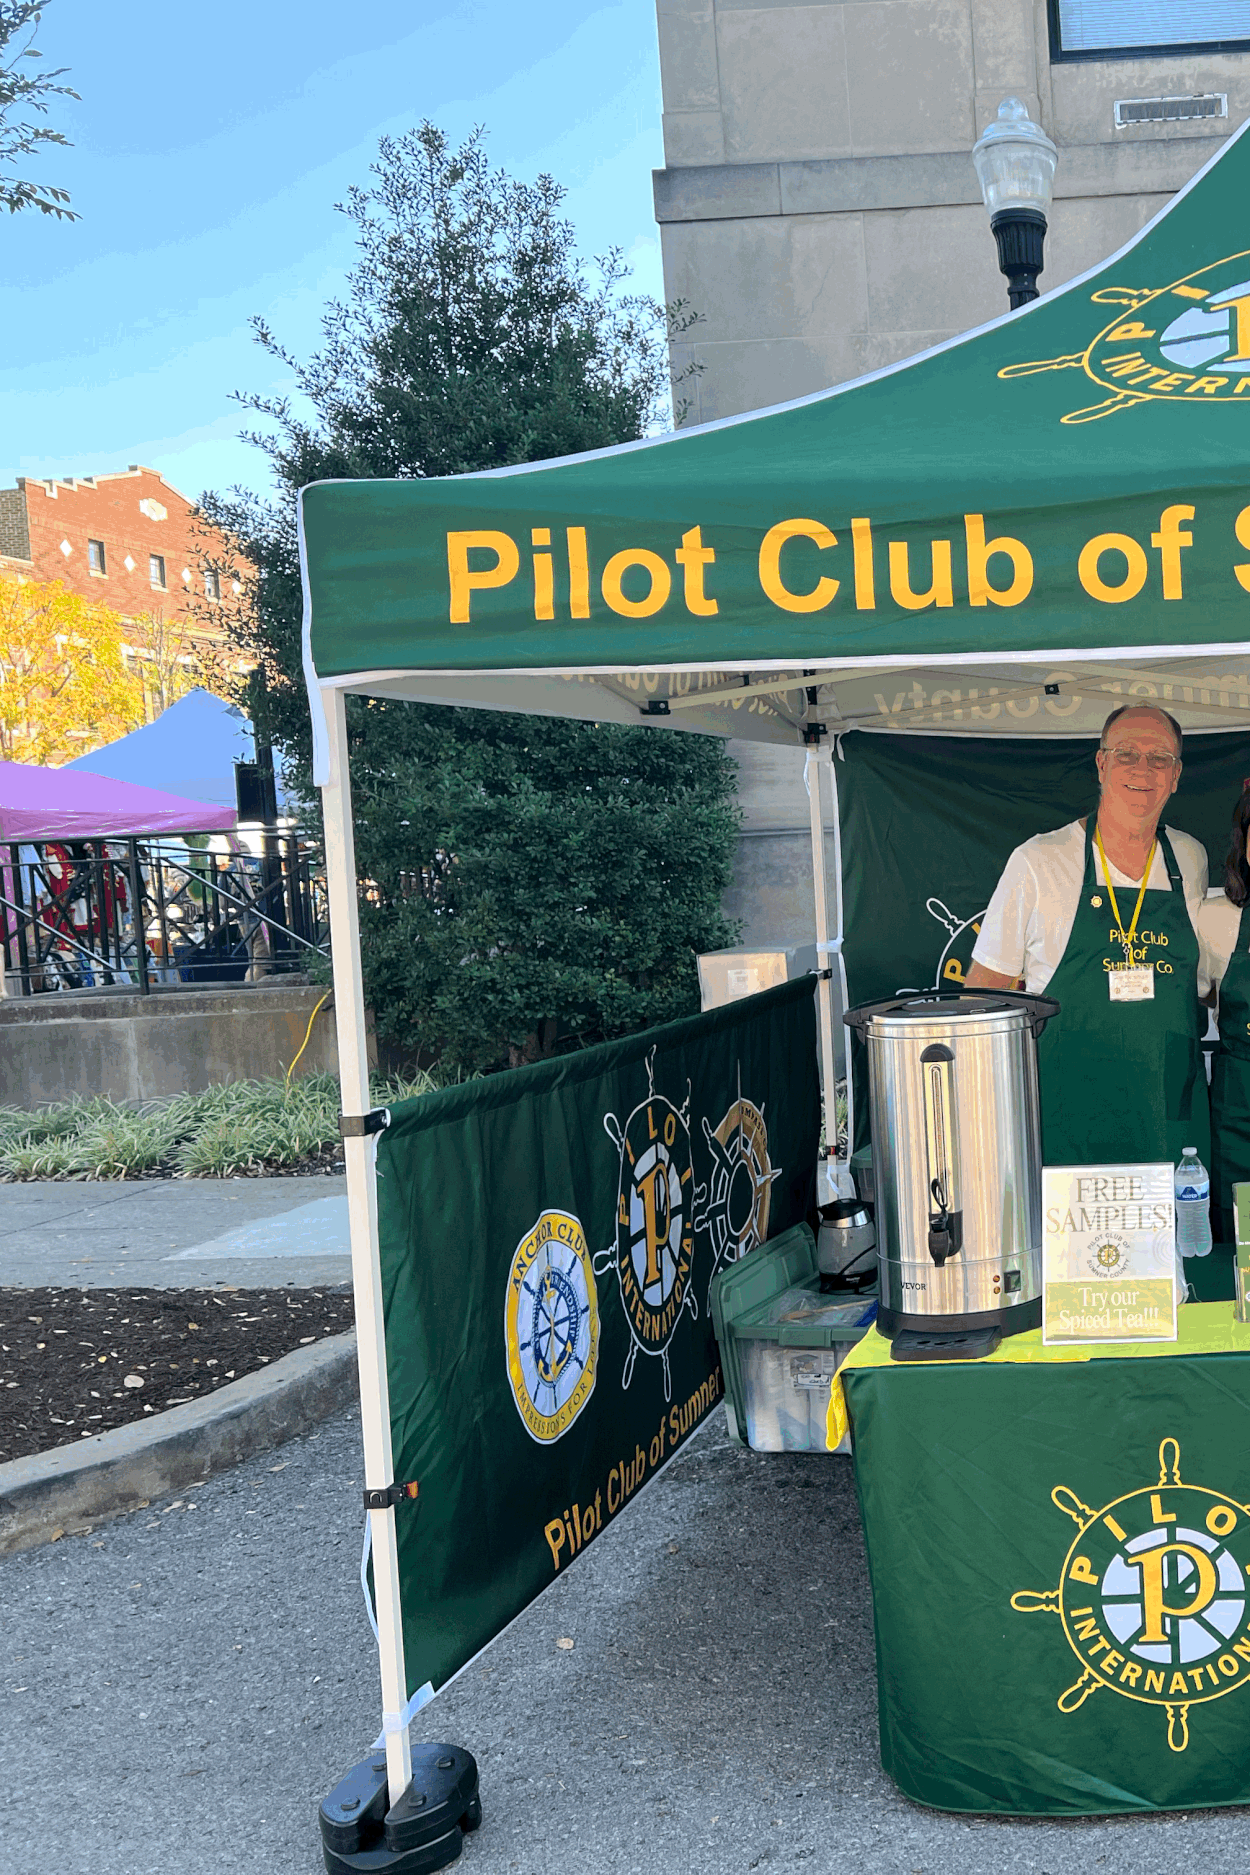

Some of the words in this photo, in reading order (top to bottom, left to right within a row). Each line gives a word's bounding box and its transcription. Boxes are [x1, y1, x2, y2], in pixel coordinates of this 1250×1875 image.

[447, 526, 718, 623] Pilot
[759, 514, 1033, 613] Club
[1078, 505, 1195, 603] of
[1110, 929, 1139, 943] Pit
[1141, 931, 1169, 946] Club
[1134, 946, 1148, 960] of
[1156, 960, 1174, 974] Co.
[1076, 1176, 1144, 1202] FREE
[1046, 1203, 1172, 1233] SAMPLES!
[1087, 1234, 1103, 1250] PILOT
[1105, 1233, 1123, 1242] CLUB
[1123, 1240, 1130, 1249] OF
[512, 1221, 553, 1292] ANCHOR
[558, 1222, 586, 1262] CLUB
[1086, 1259, 1108, 1279] SUMNER
[1110, 1258, 1130, 1279] COUNTY
[901, 1282, 926, 1290] VEVOR
[1078, 1287, 1108, 1310] Try
[1111, 1290, 1140, 1305] our
[550, 1274, 577, 1338] RIENDSHIP
[1059, 1308, 1110, 1334] Spiced
[1114, 1307, 1159, 1328] Tea!!!
[517, 1383, 566, 1435] IMPRESSIONS
[568, 1382, 587, 1415] FOR
[544, 1487, 602, 1571] Pilot
[607, 1444, 646, 1515] Club
[650, 1415, 666, 1467] of
[669, 1366, 720, 1446] Sumner
